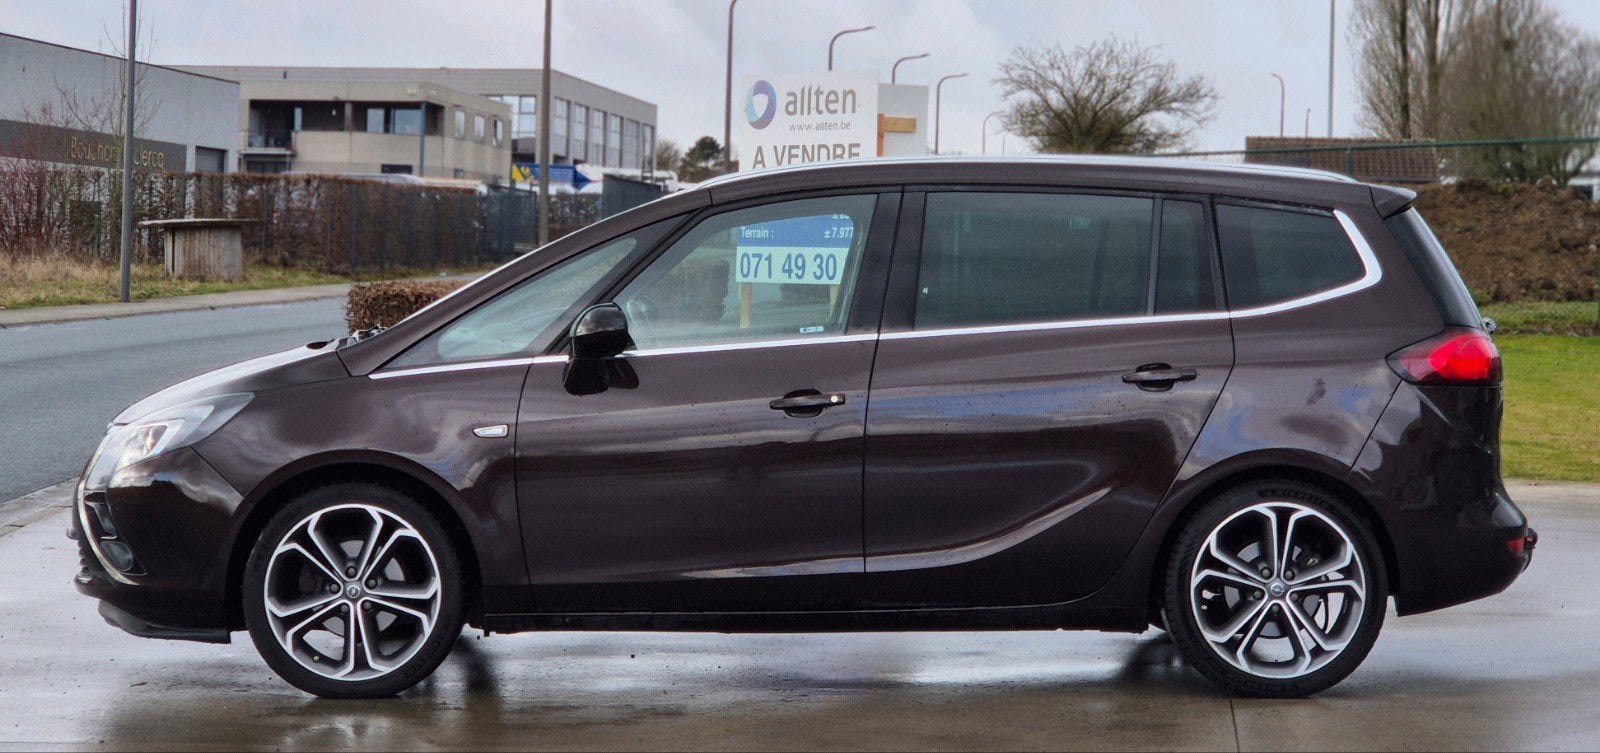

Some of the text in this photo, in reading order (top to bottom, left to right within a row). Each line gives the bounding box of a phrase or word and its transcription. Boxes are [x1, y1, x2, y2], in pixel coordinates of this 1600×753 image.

[784, 84, 857, 116] allten
[788, 120, 851, 132] www.allten.be
[752, 142, 861, 170] A VENDRE
[740, 226, 769, 239] Terrain
[740, 252, 838, 280] 071 49 30
